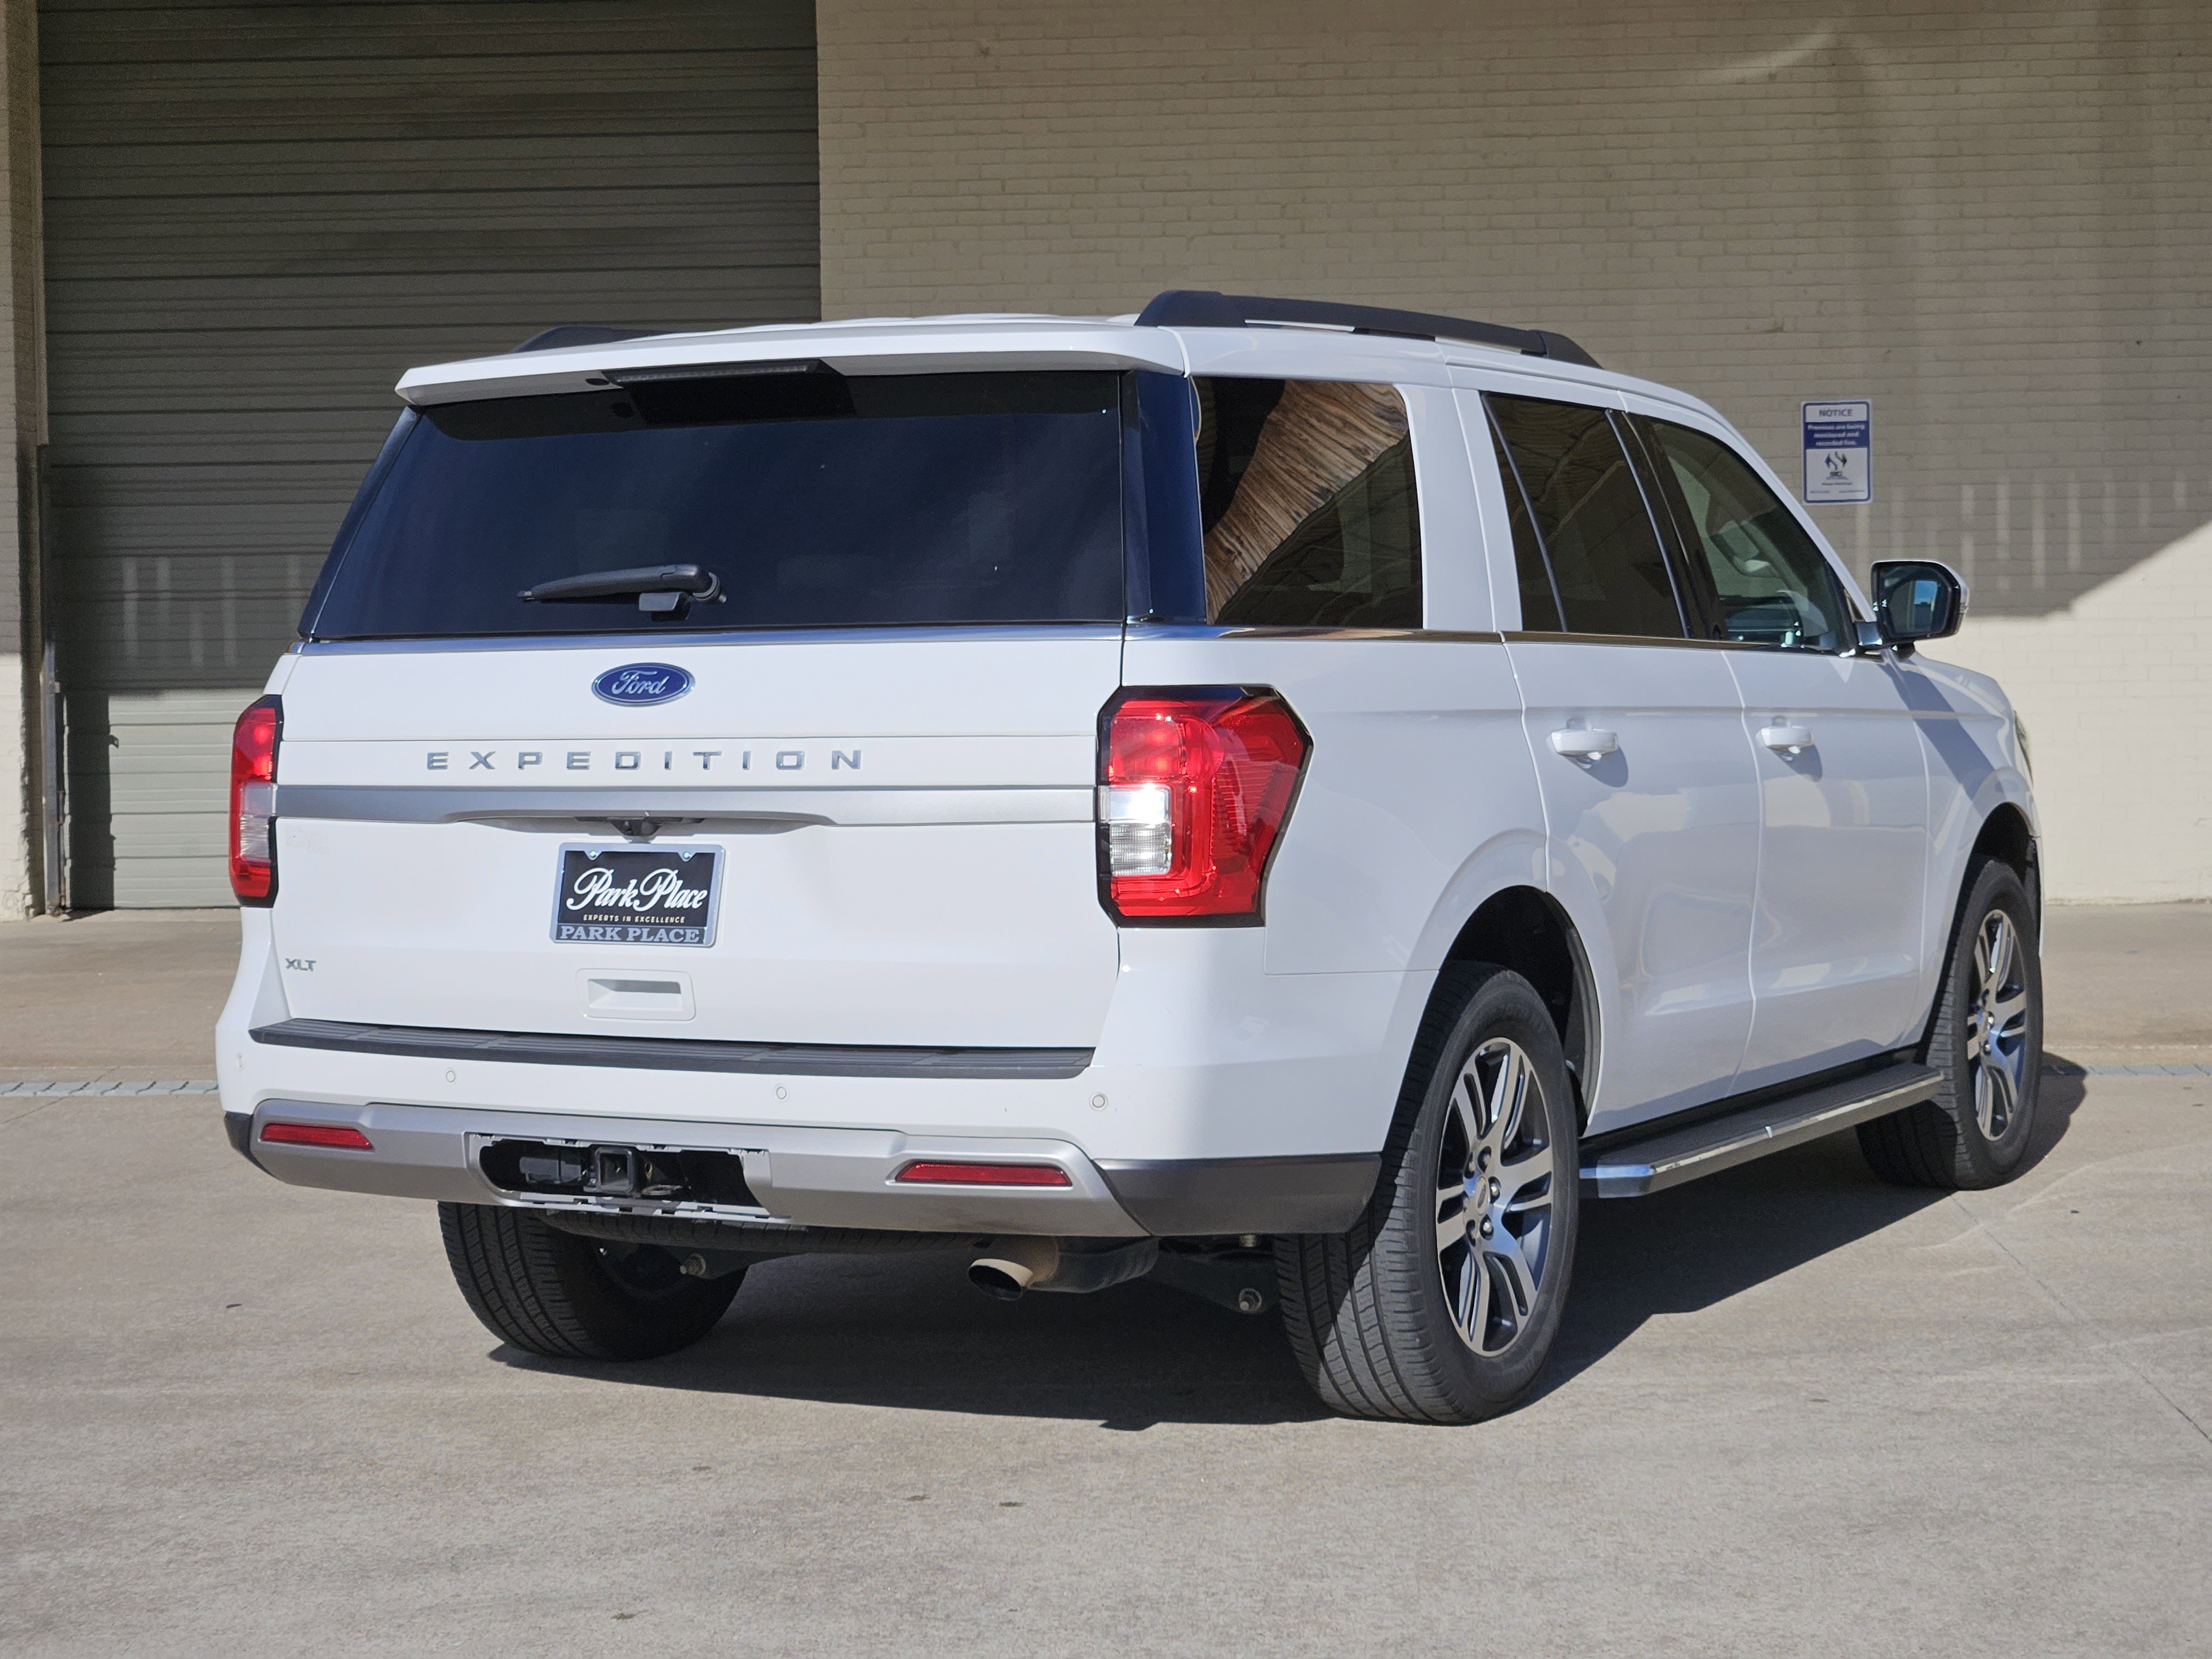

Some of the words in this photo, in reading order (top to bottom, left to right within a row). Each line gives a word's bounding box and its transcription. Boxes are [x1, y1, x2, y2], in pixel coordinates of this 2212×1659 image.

[1819, 409, 1853, 417] NOTICE
[612, 670, 667, 695] Ford
[427, 749, 862, 770] EXPEDITION
[566, 868, 638, 910] Park
[633, 868, 708, 911] Place
[560, 926, 622, 941] PARK
[626, 927, 700, 943] PLACE
[285, 958, 317, 972] XLT
